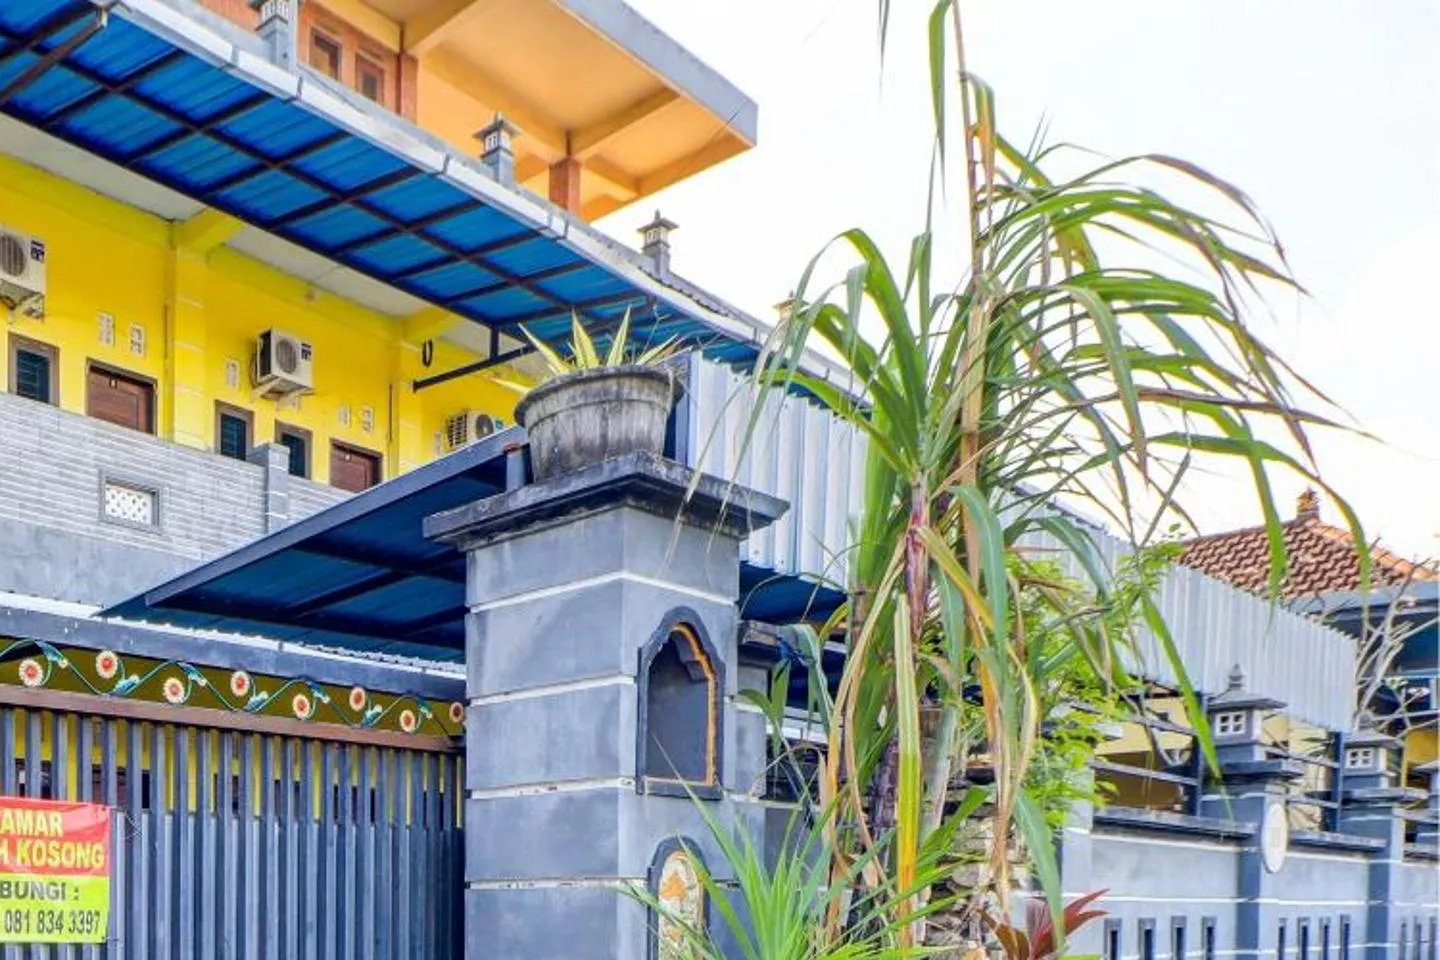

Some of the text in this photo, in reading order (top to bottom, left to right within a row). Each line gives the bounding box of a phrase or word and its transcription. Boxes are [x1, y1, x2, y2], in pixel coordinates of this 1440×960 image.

[15, 841, 105, 869] KOSONG
[5, 909, 30, 934] 081
[37, 910, 64, 934] 834
[68, 910, 101, 934] 3397
